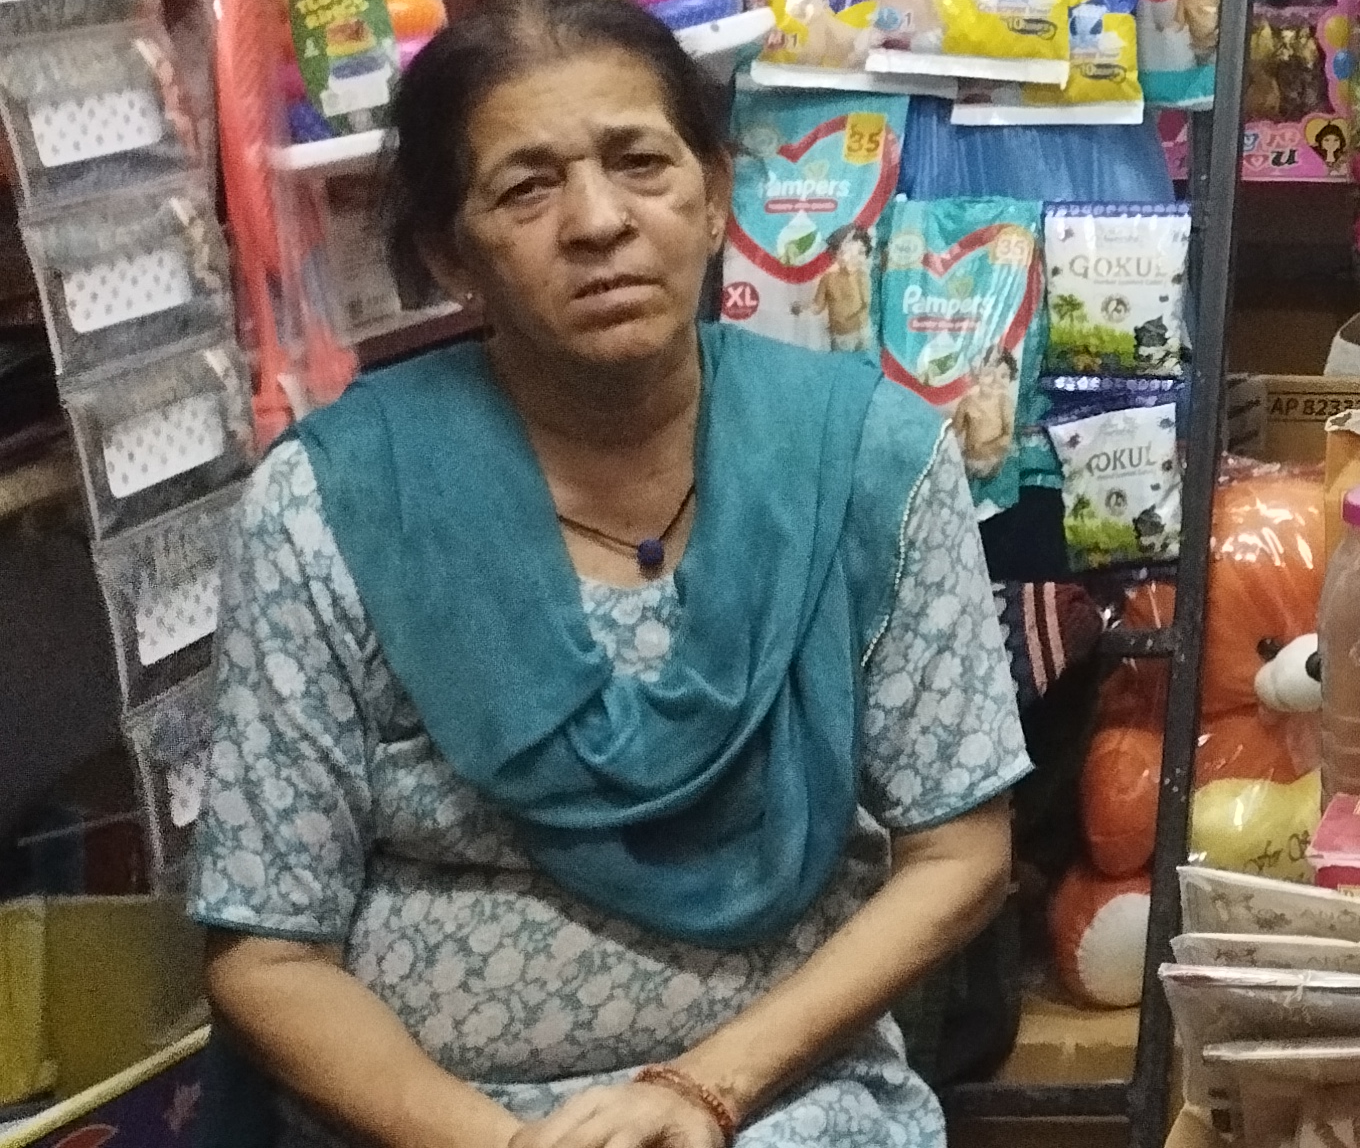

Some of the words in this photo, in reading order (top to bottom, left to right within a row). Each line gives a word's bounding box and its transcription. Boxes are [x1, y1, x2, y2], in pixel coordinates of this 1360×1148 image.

[847, 123, 881, 153] 35
[1069, 254, 1168, 279] GOKUL
[725, 286, 758, 308] XL
[1270, 397, 1299, 416] AP
